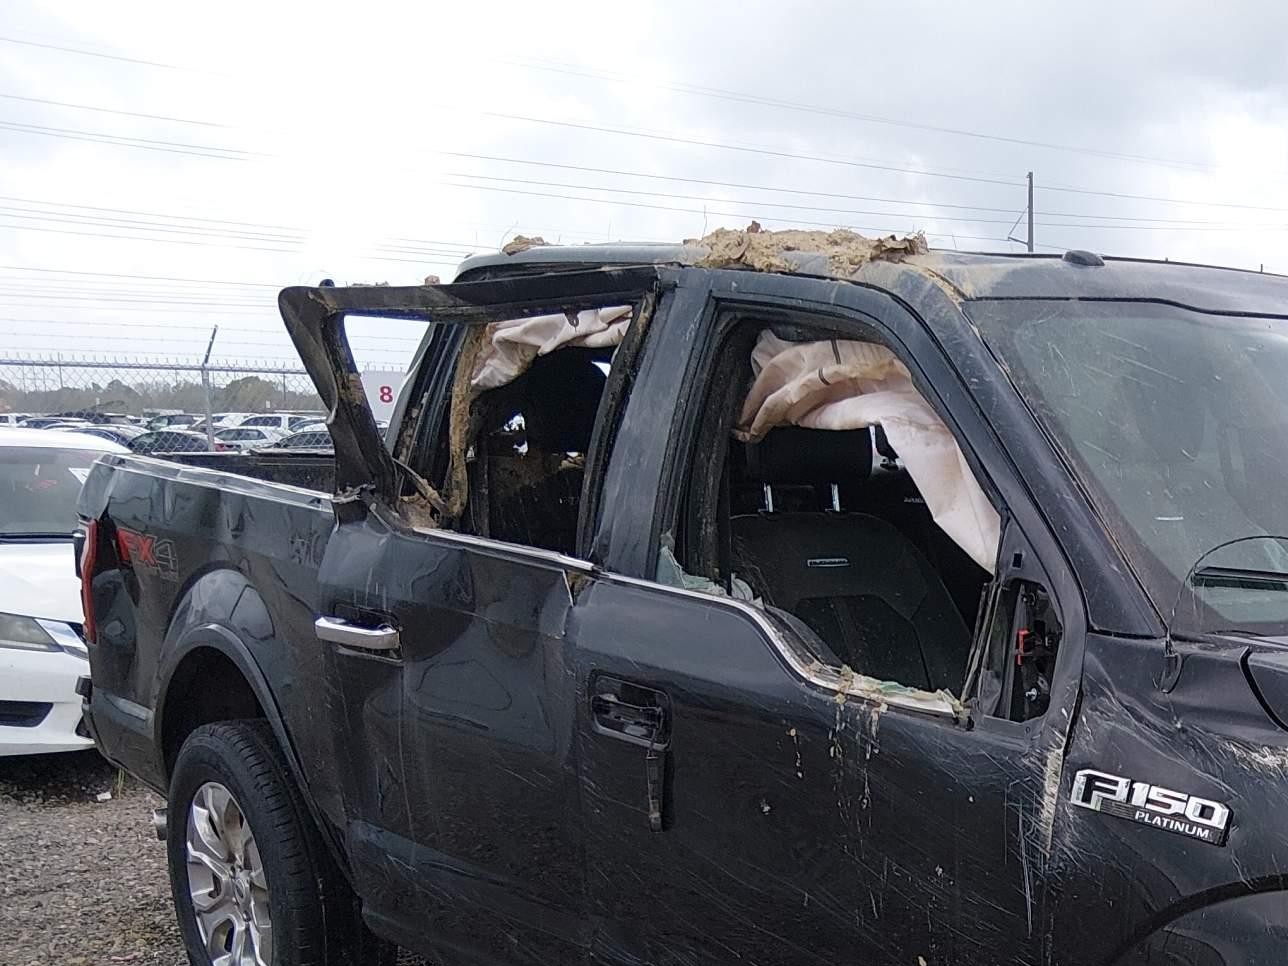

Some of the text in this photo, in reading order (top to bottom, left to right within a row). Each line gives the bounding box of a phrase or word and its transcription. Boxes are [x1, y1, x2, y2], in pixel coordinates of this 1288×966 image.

[379, 385, 394, 404] 8
[114, 527, 178, 574] FX4
[1134, 809, 1210, 839] PLATINUM
